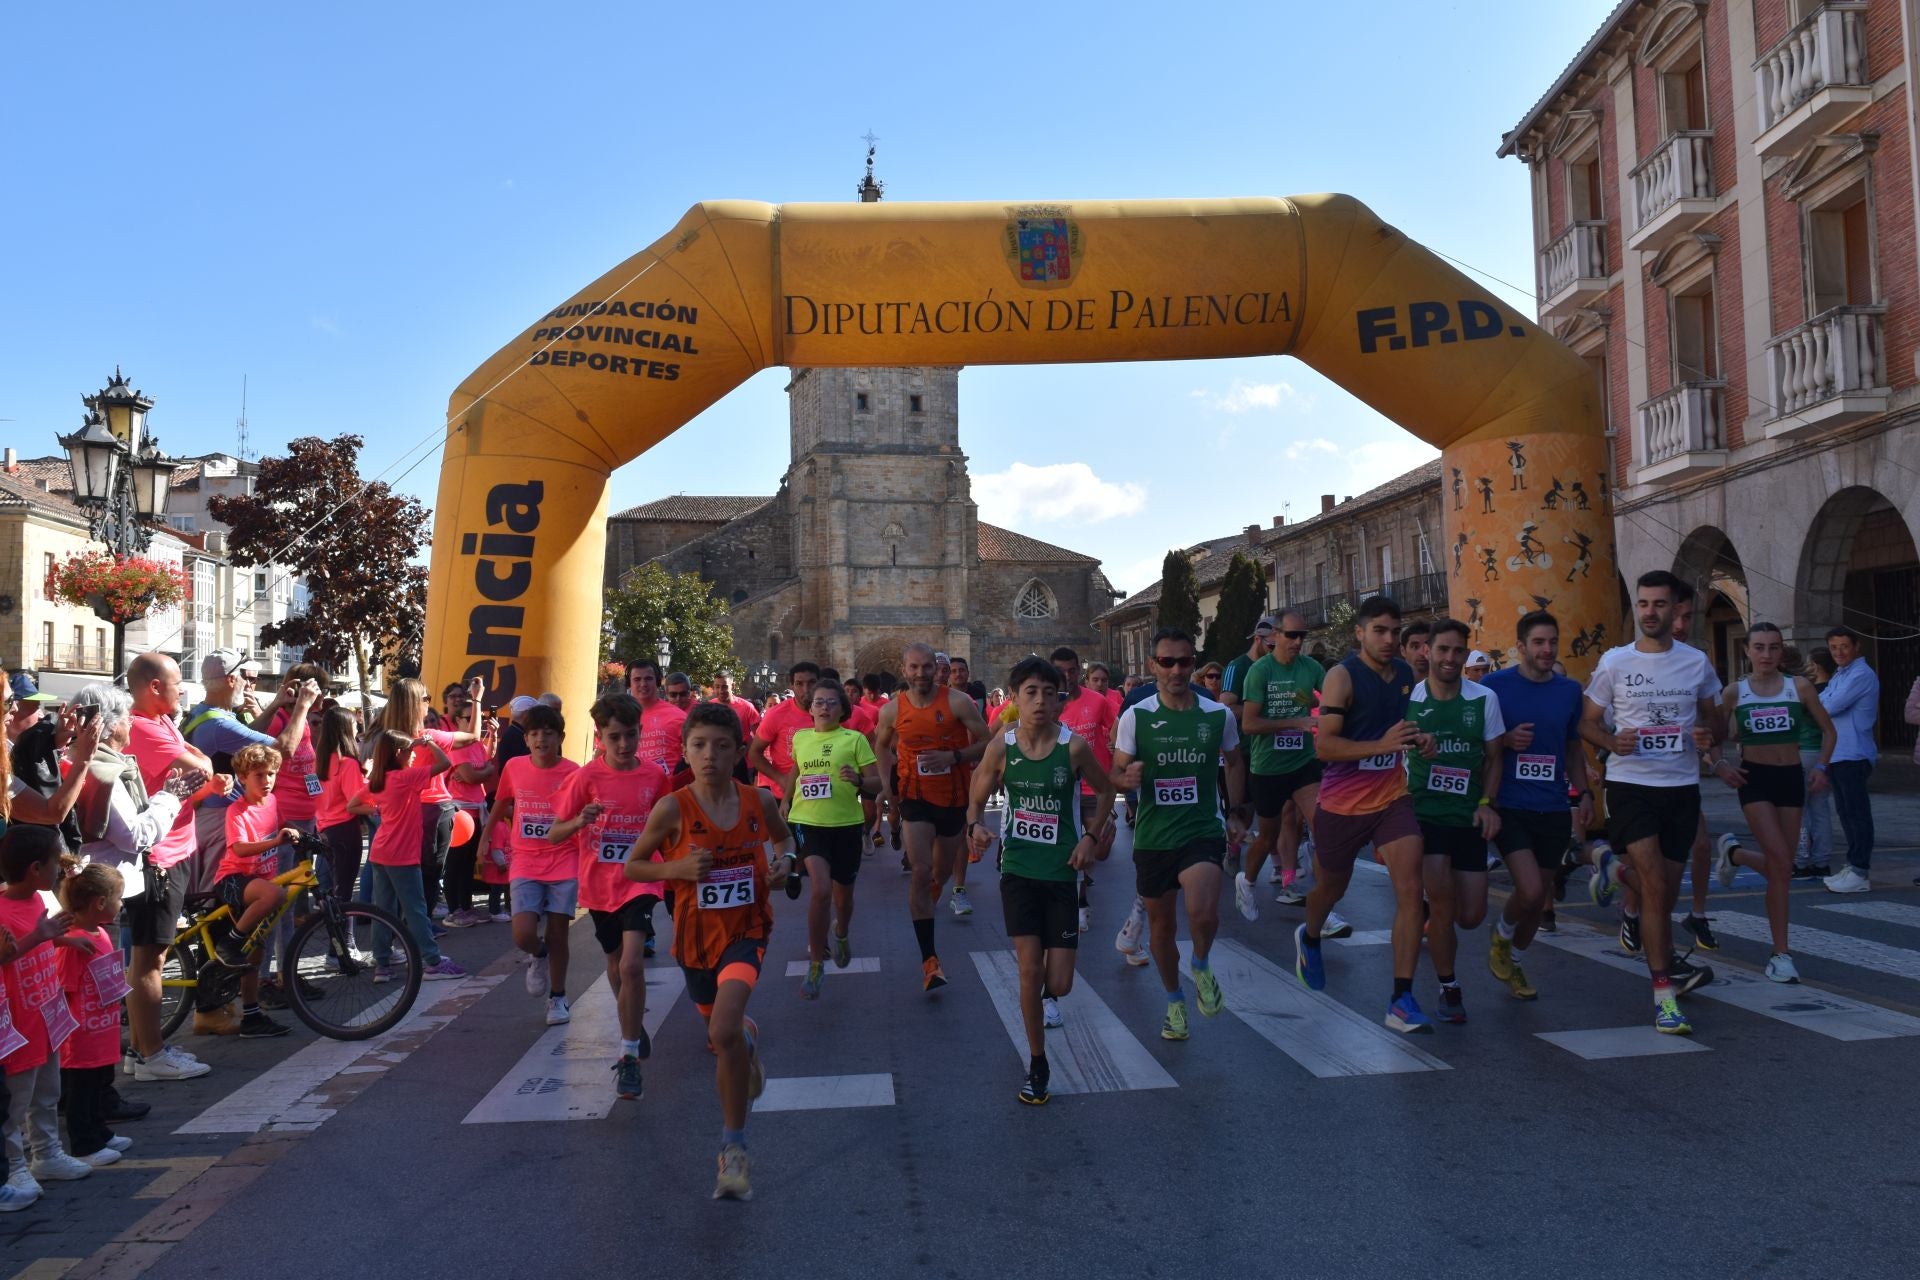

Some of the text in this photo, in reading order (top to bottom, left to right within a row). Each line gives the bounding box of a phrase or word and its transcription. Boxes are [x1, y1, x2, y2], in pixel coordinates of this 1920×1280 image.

[541, 298, 698, 325] FUNDACIÓN
[784, 288, 1292, 335] DIPUTACIÓN DE PALENCIA
[1356, 301, 1526, 354] F.P.D.
[532, 325, 698, 355] PROVINCIAL
[529, 350, 680, 382] DEPORTES
[1267, 684, 1278, 692] En
[1268, 691, 1297, 700] marcha
[1268, 706, 1276, 714] el
[1754, 716, 1788, 731] 682
[1277, 737, 1302, 748] 694
[1642, 735, 1679, 750] 657
[803, 758, 831, 770] gullón
[1157, 747, 1207, 766] gullón
[1519, 763, 1553, 778] 695
[307, 781, 320, 793] 238
[802, 784, 828, 797] 697
[1431, 775, 1466, 791] 656
[1159, 787, 1195, 802] 665
[1019, 795, 1061, 811] gullón
[1016, 820, 1055, 840] 666
[602, 844, 630, 860] 67
[702, 880, 751, 905] 675
[19, 956, 38, 972] En
